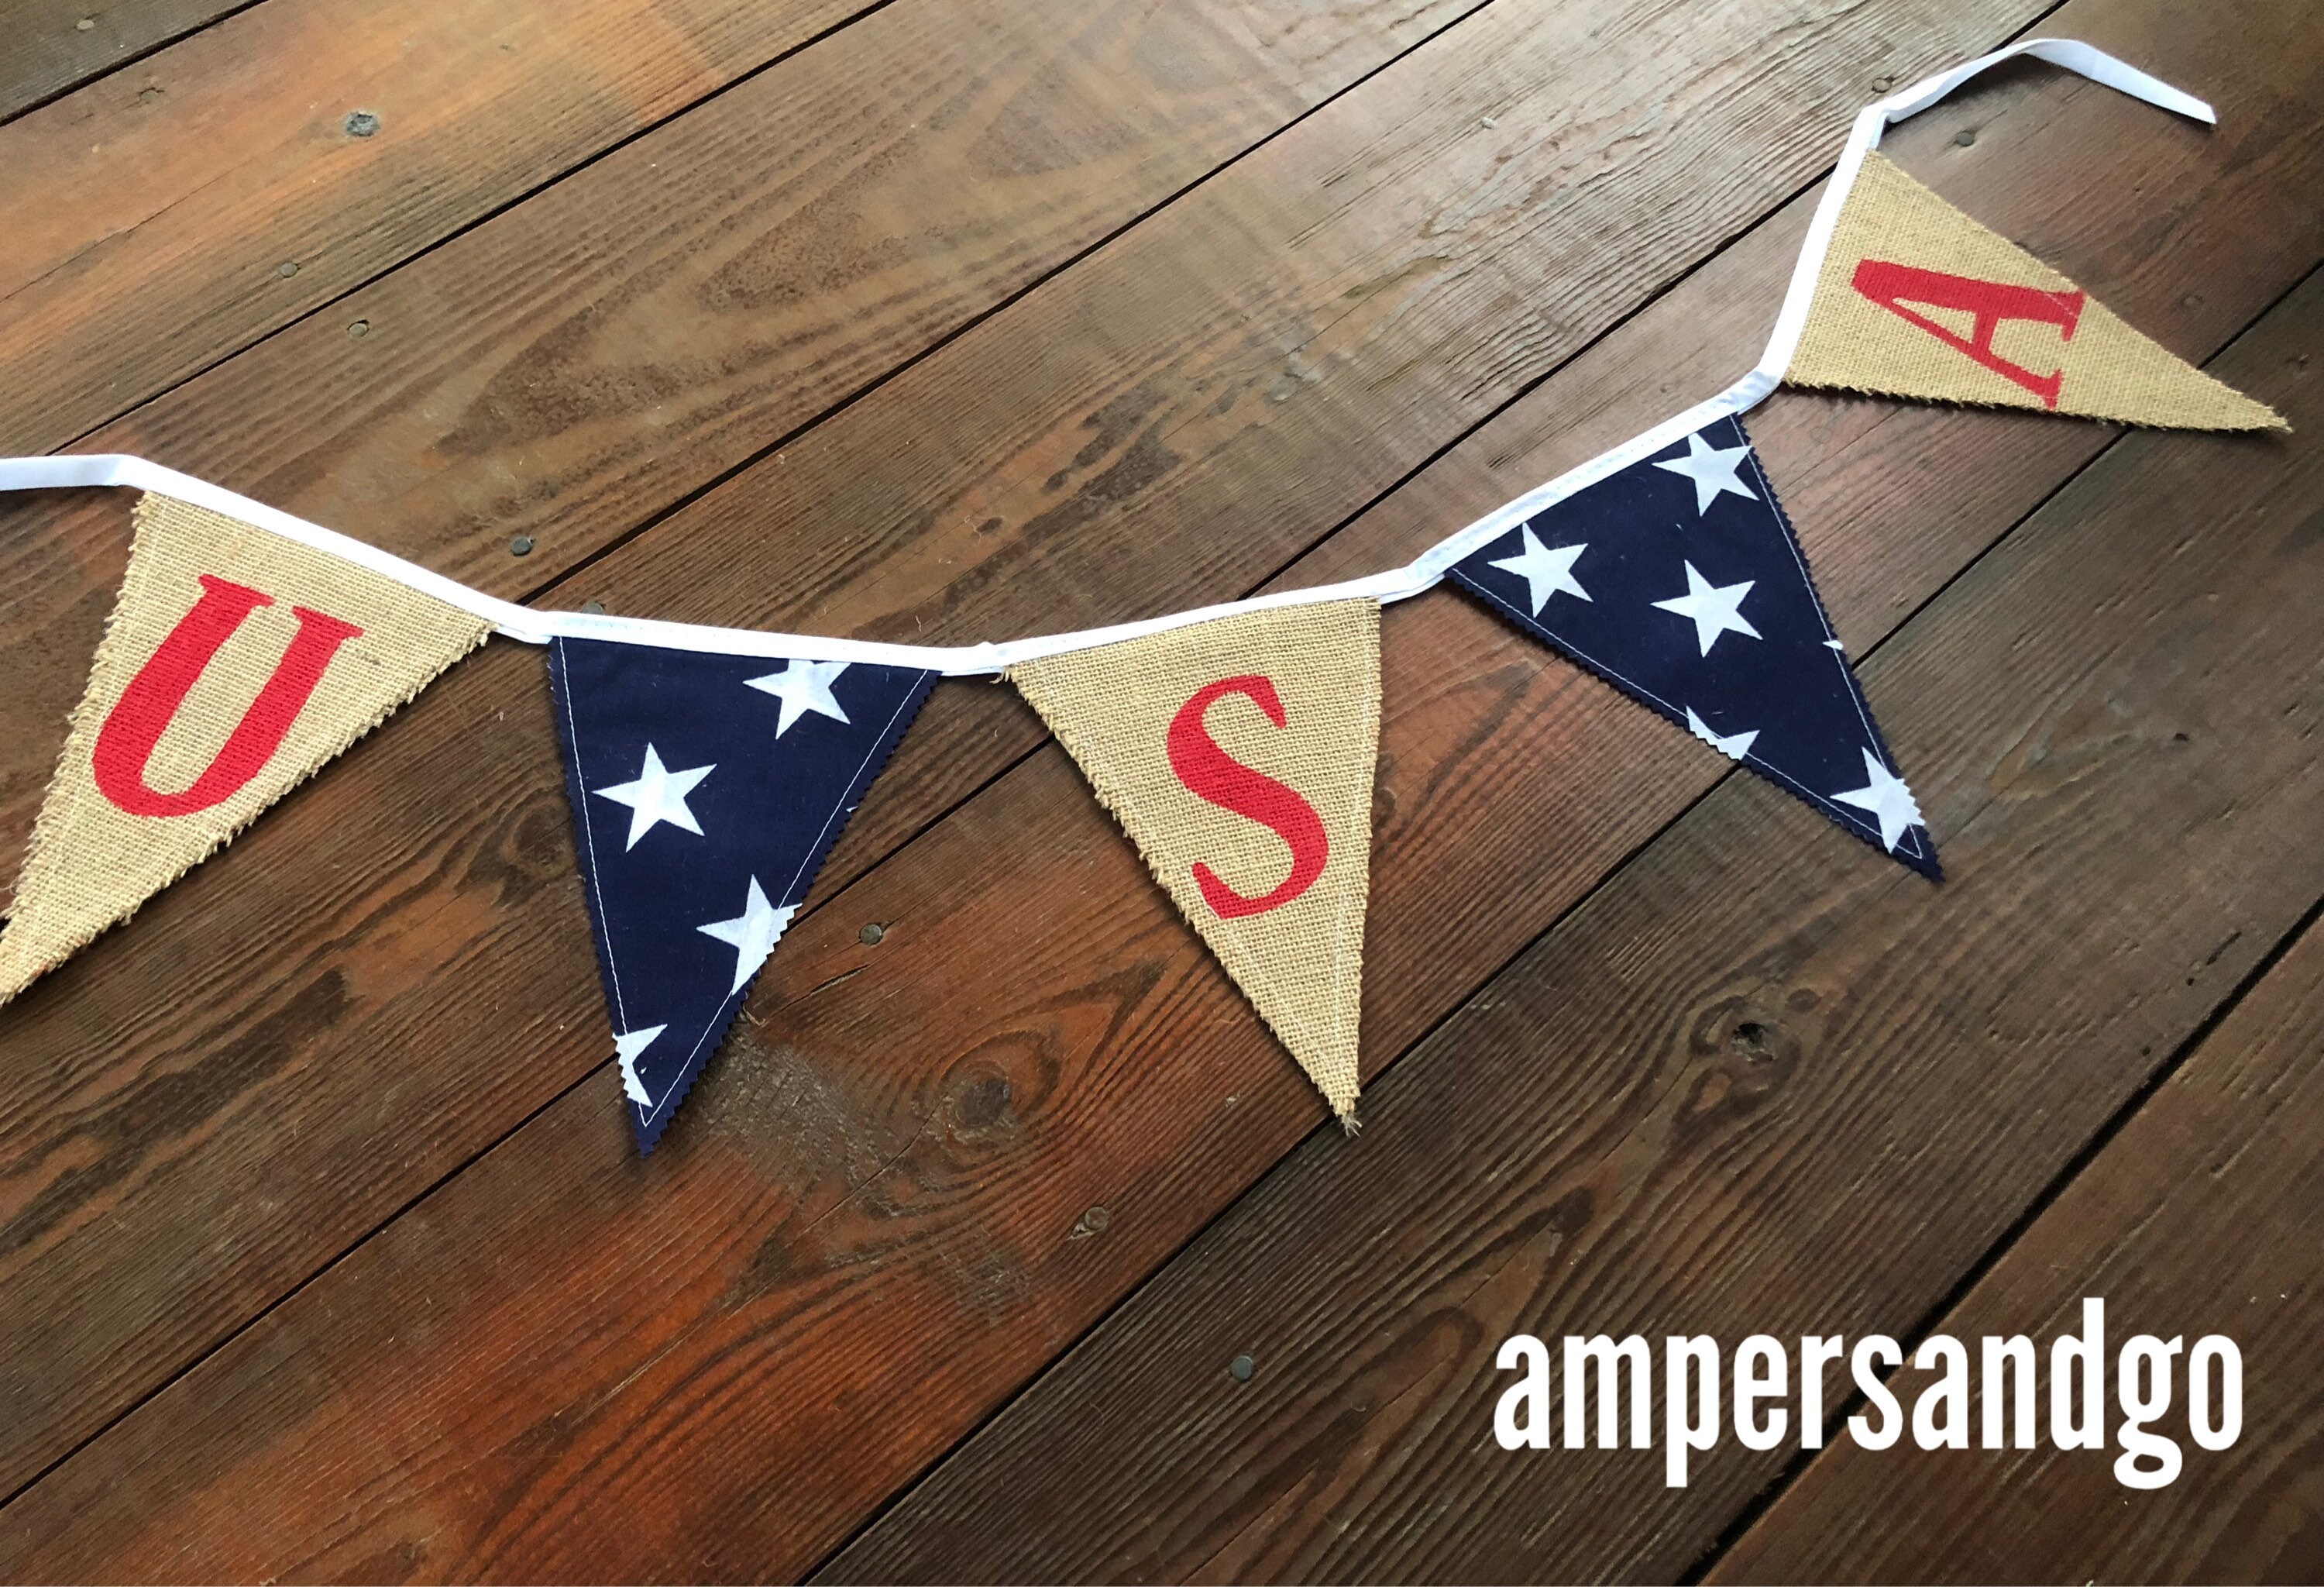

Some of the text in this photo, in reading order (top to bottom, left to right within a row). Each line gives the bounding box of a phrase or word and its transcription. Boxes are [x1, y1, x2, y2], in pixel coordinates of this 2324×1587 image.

[92, 259, 2084, 920] U S A
